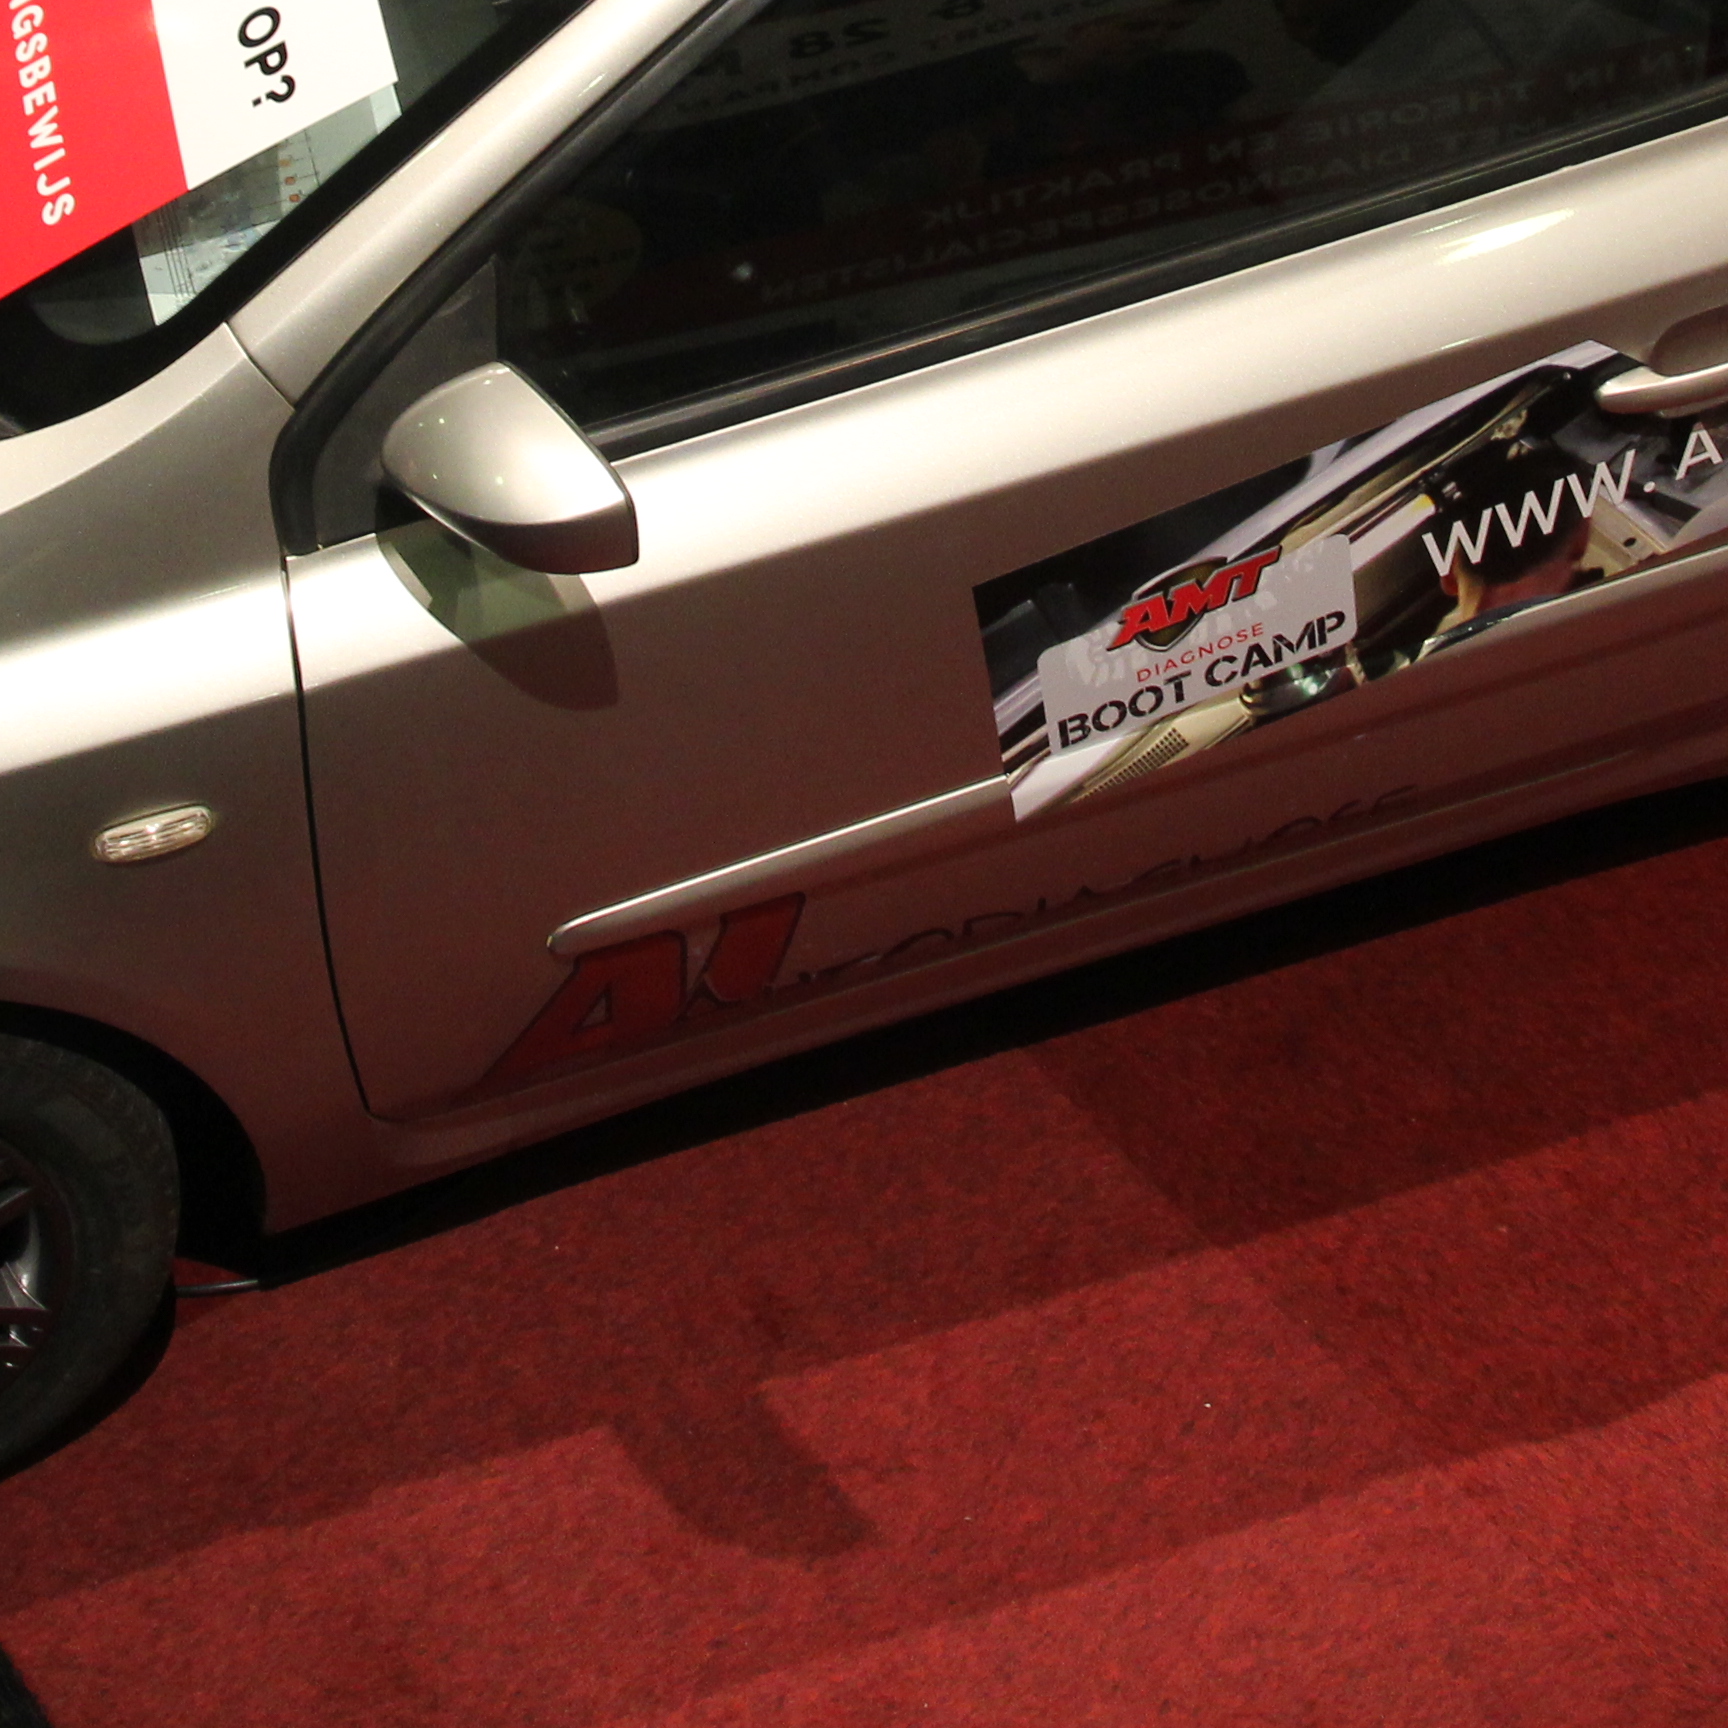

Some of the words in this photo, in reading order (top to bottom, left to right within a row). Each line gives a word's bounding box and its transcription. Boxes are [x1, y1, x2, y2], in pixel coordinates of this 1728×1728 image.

[237, 6, 296, 108] OP?
[1106, 544, 1283, 652] AMT
[1058, 671, 1192, 749] BOOT
[1204, 610, 1347, 687] CAMP
[1136, 622, 1265, 683] DIAGNOSE
